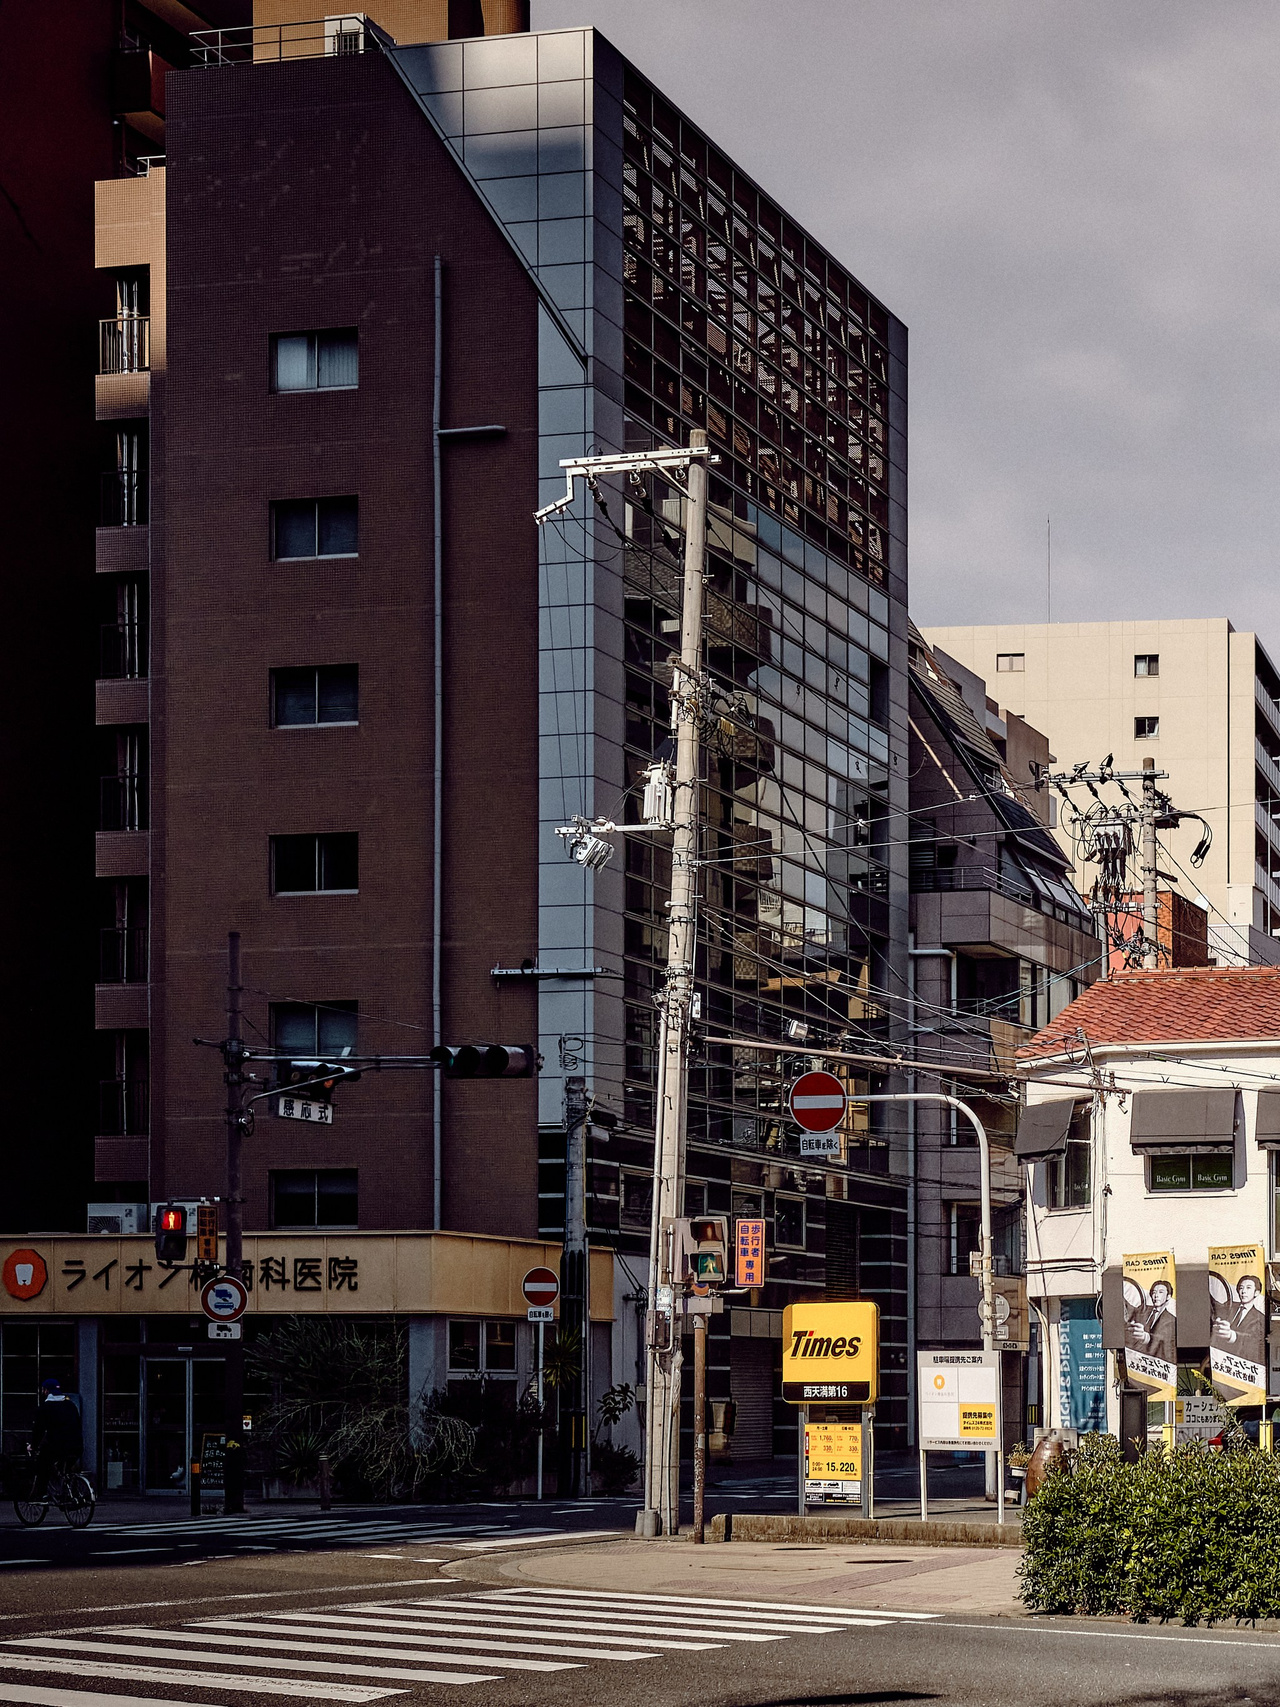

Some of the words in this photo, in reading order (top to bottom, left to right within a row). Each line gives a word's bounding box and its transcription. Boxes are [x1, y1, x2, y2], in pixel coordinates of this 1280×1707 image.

[284, 1099, 329, 1121] 感応式
[1156, 1174, 1171, 1183] Basic
[1172, 1174, 1186, 1185] Gym
[1197, 1173, 1212, 1182] Basic
[1213, 1173, 1228, 1183] Gym
[740, 1224, 749, 1257] 自転車
[751, 1224, 760, 1257] 歩行者
[791, 1331, 861, 1357] Times
[803, 1386, 847, 1398] 西天満第16
